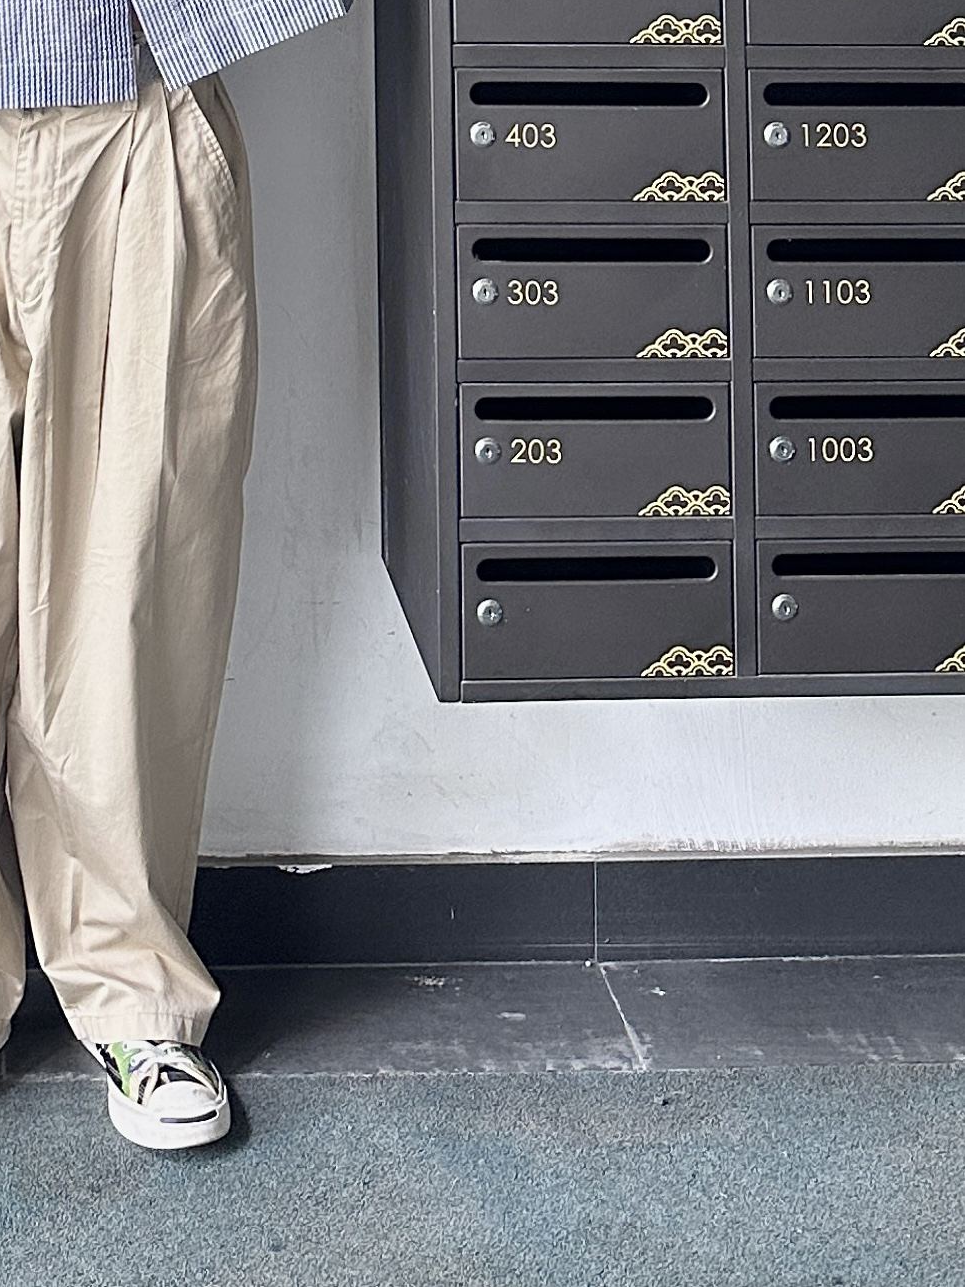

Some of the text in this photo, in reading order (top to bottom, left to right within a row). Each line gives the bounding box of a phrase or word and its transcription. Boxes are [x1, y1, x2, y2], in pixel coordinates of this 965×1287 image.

[504, 123, 557, 149] 403
[801, 122, 867, 148] 1203
[506, 279, 559, 306] 303
[805, 279, 871, 305] 1103
[510, 438, 562, 464] 203
[808, 437, 874, 462] 1003
